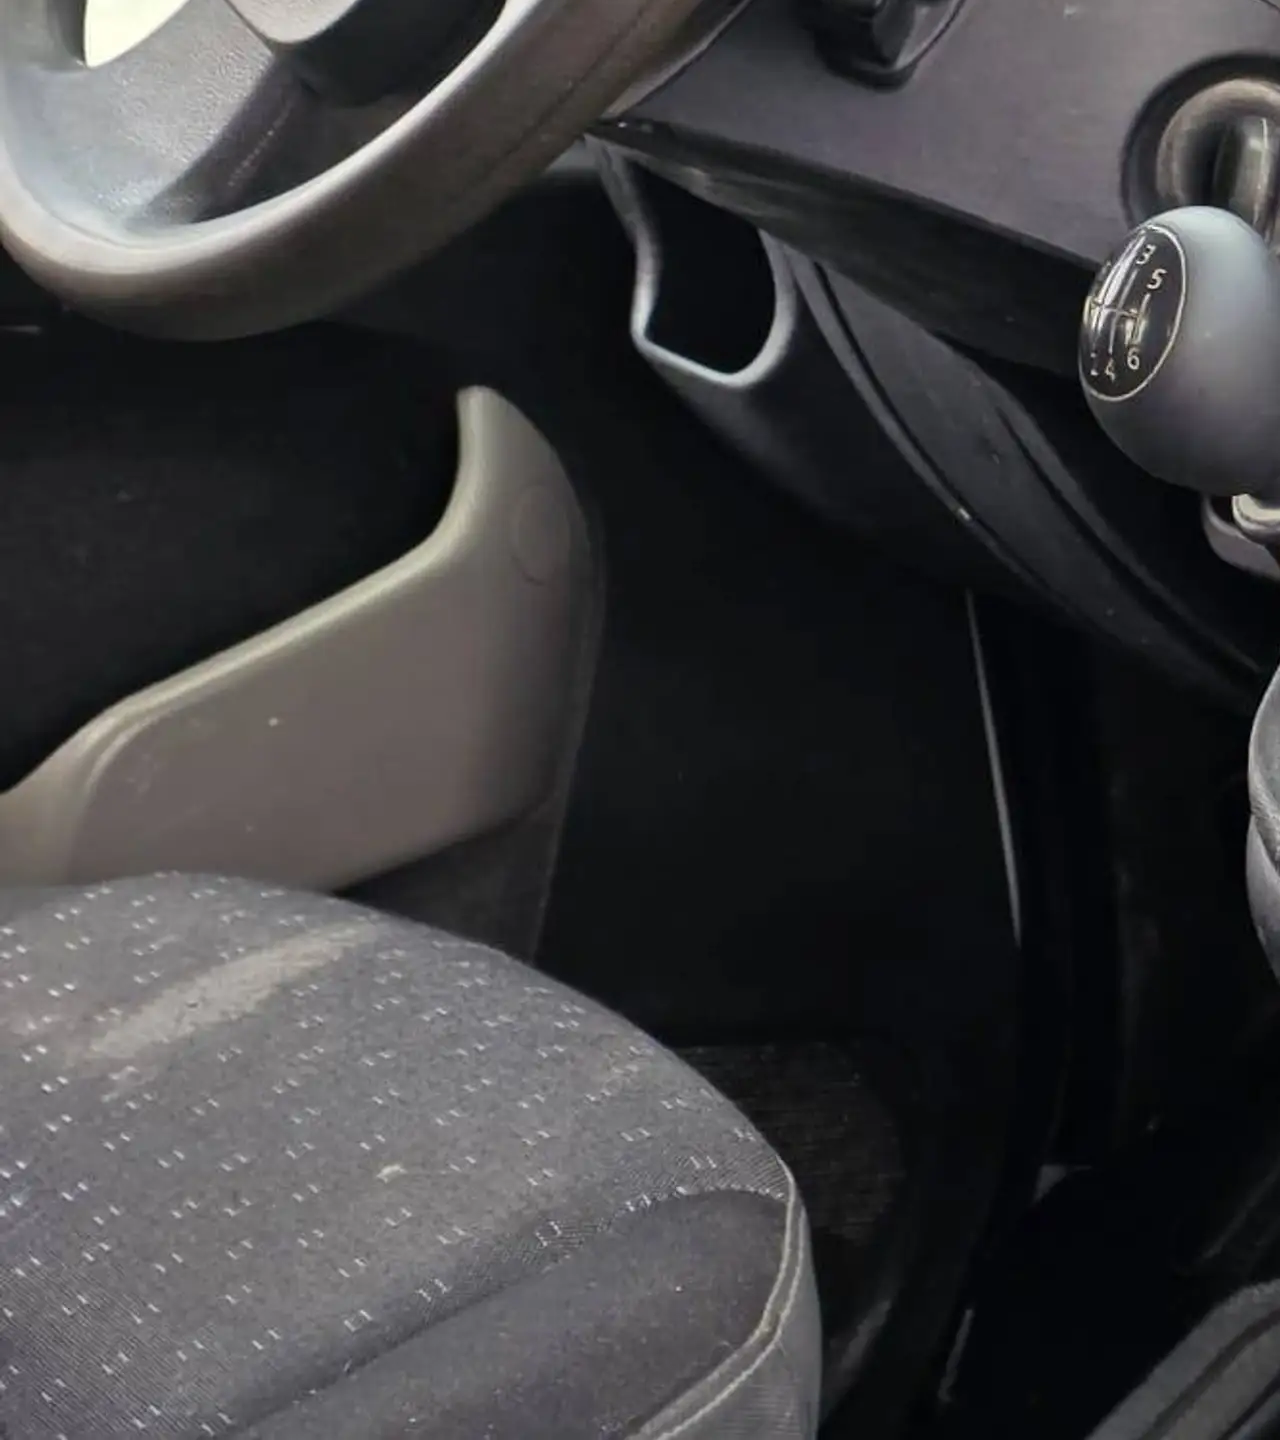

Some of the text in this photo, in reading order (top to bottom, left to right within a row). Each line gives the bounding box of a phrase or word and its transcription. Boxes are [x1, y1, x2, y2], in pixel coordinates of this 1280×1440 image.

[1134, 244, 1157, 266] 3
[1146, 268, 1168, 290] 5
[1126, 347, 1141, 371] 6
